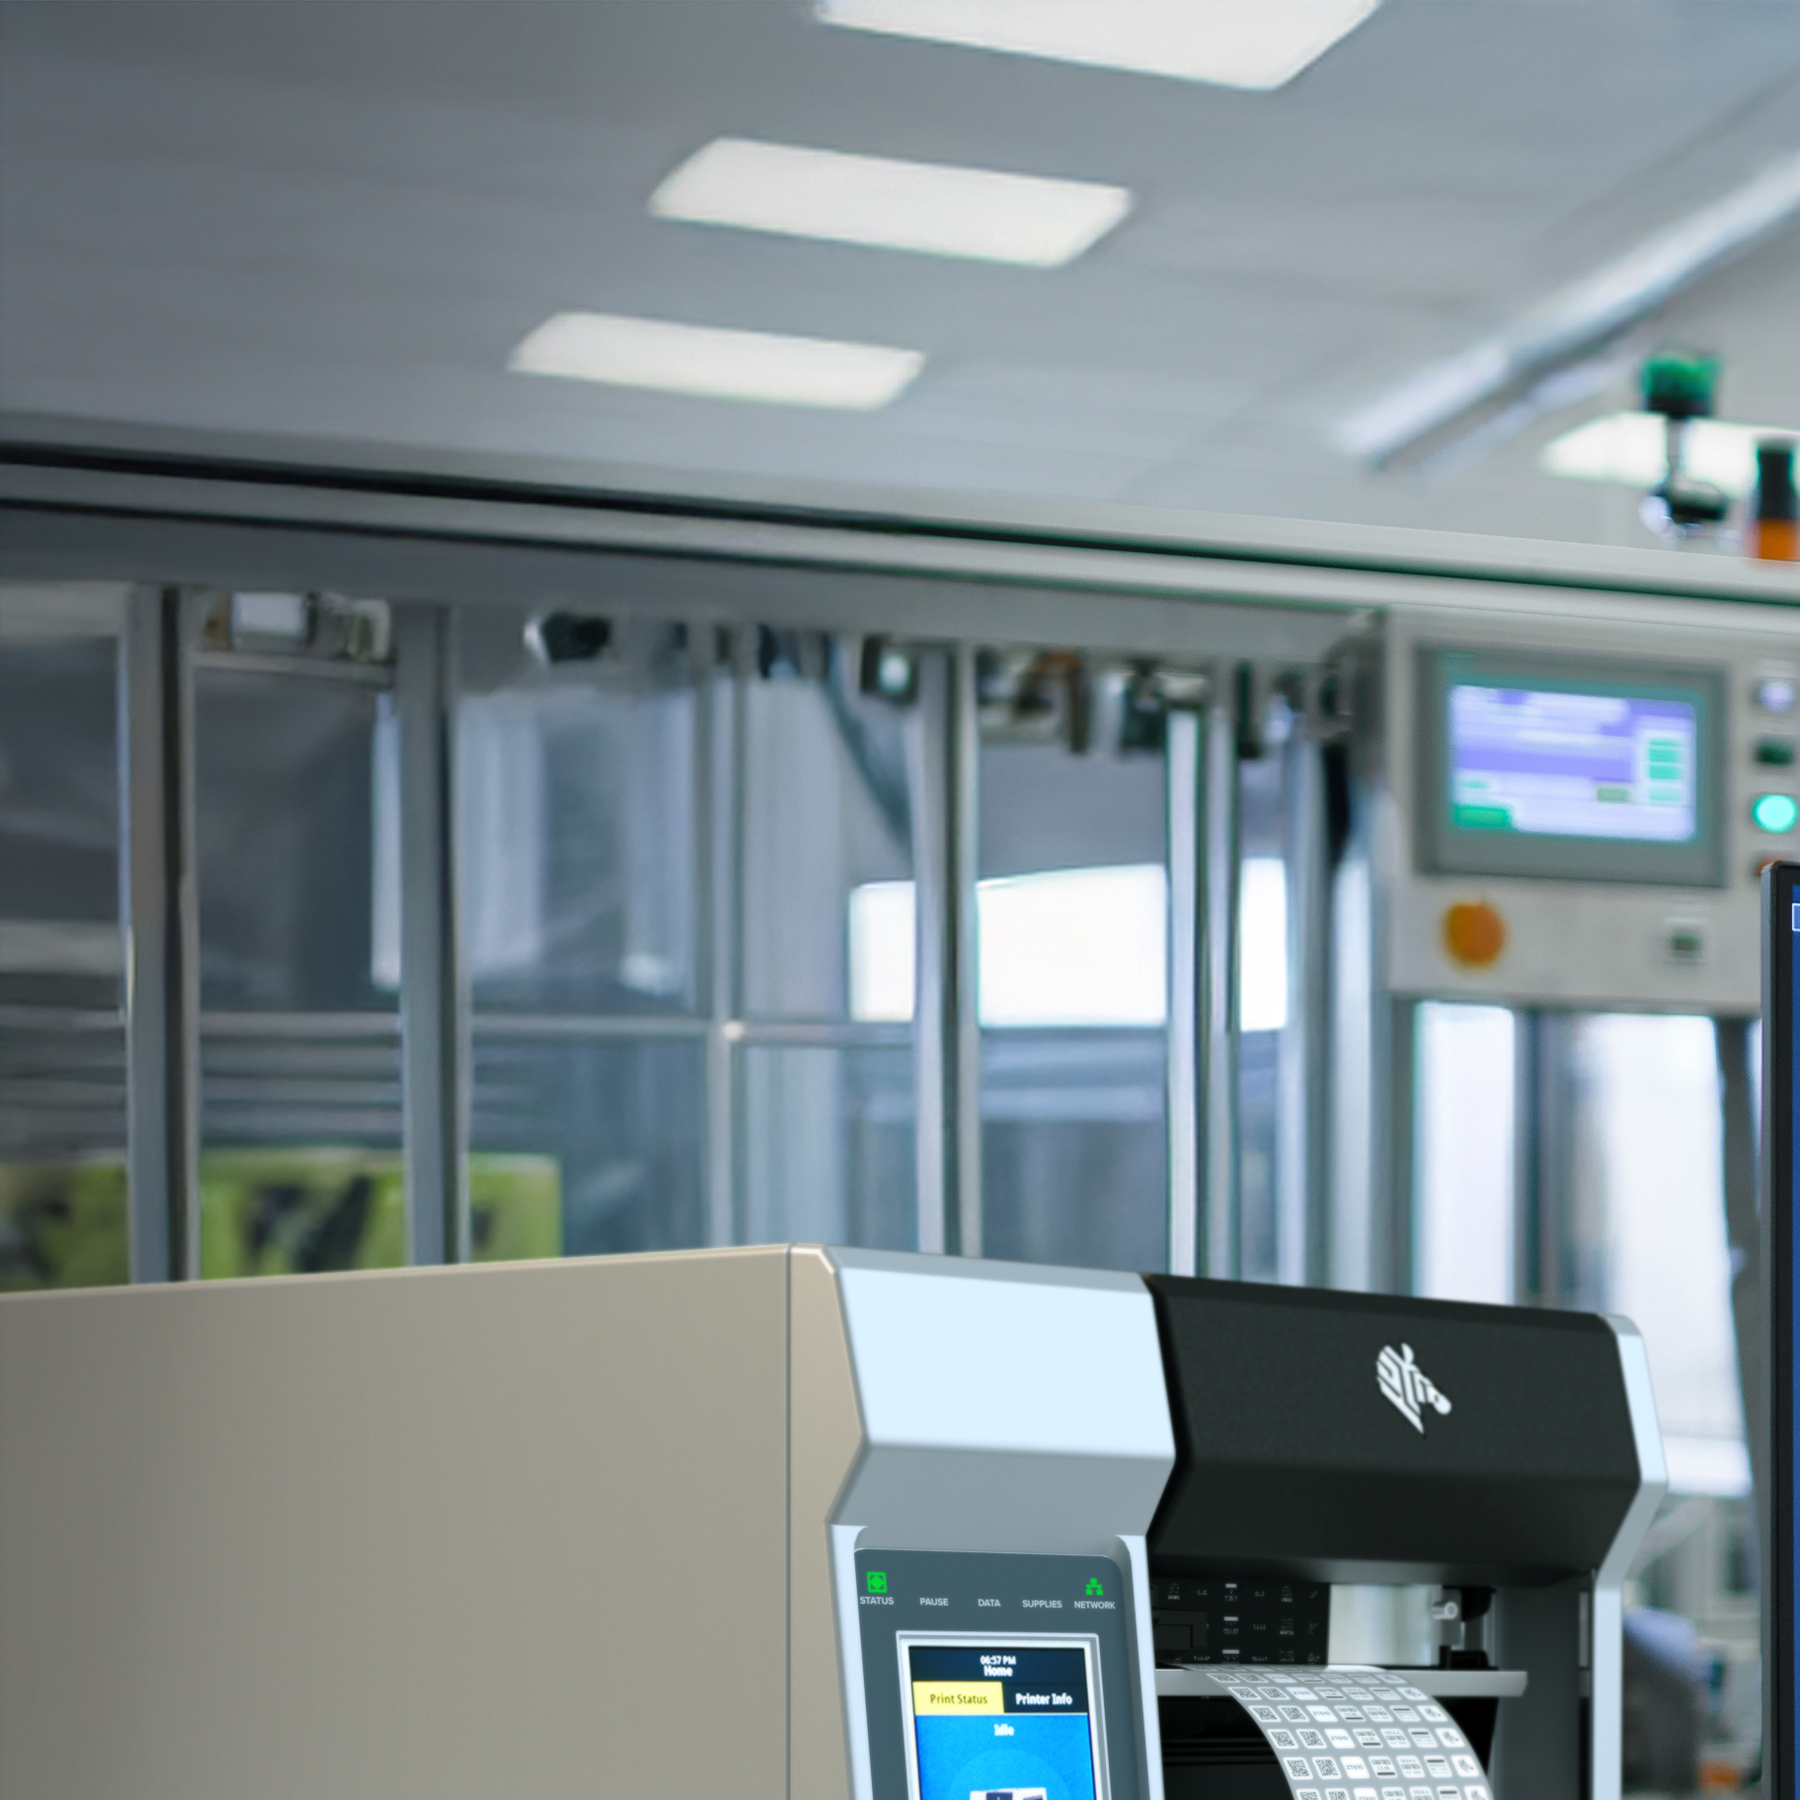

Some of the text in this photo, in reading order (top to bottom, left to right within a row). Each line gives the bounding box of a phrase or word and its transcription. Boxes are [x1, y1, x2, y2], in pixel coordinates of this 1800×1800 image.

[859, 1595, 895, 1606] STATUS
[919, 1597, 949, 1607] PAUSE
[977, 1598, 1002, 1607] DATA
[1022, 1599, 1063, 1609] SUPPLIES
[1073, 1600, 1116, 1610] NETWORK
[1004, 1657, 1016, 1665] PM
[984, 1666, 1013, 1676] Home
[930, 1694, 988, 1705] Print Status
[1015, 1692, 1073, 1706] Printer Info
[993, 1723, 1015, 1737] Idle
